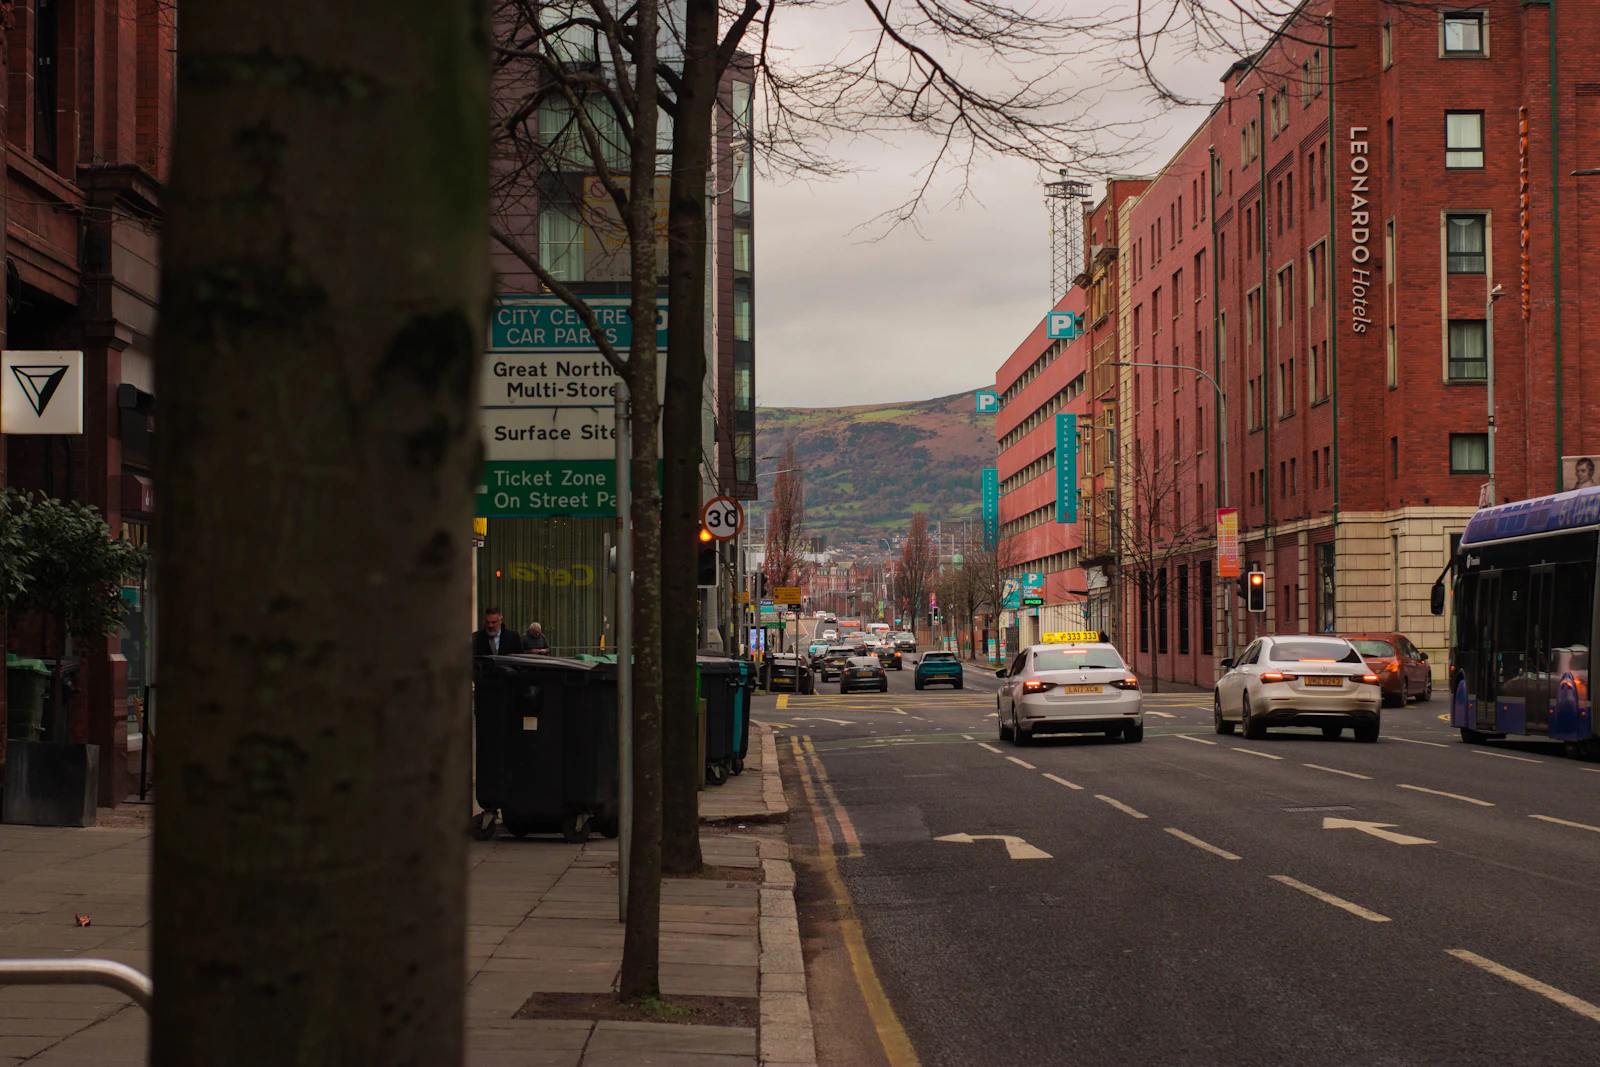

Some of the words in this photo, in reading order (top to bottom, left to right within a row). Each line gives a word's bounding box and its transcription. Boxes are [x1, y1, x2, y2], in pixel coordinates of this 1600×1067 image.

[1350, 127, 1370, 263] LEONARDO
[1352, 268, 1372, 333] Hotels
[497, 308, 541, 326] CITY
[1051, 314, 1072, 335] P
[506, 327, 546, 344] CAR
[554, 327, 618, 344] PARS
[494, 361, 547, 377] Great
[979, 394, 995, 410] P
[494, 425, 571, 441] Surface
[494, 470, 552, 486] Ticket
[561, 470, 606, 486] Zone
[494, 492, 520, 509] On
[529, 491, 588, 508] Street
[708, 509, 737, 528] 30
[1067, 632, 1081, 641] 333
[1083, 632, 1097, 640] 333
